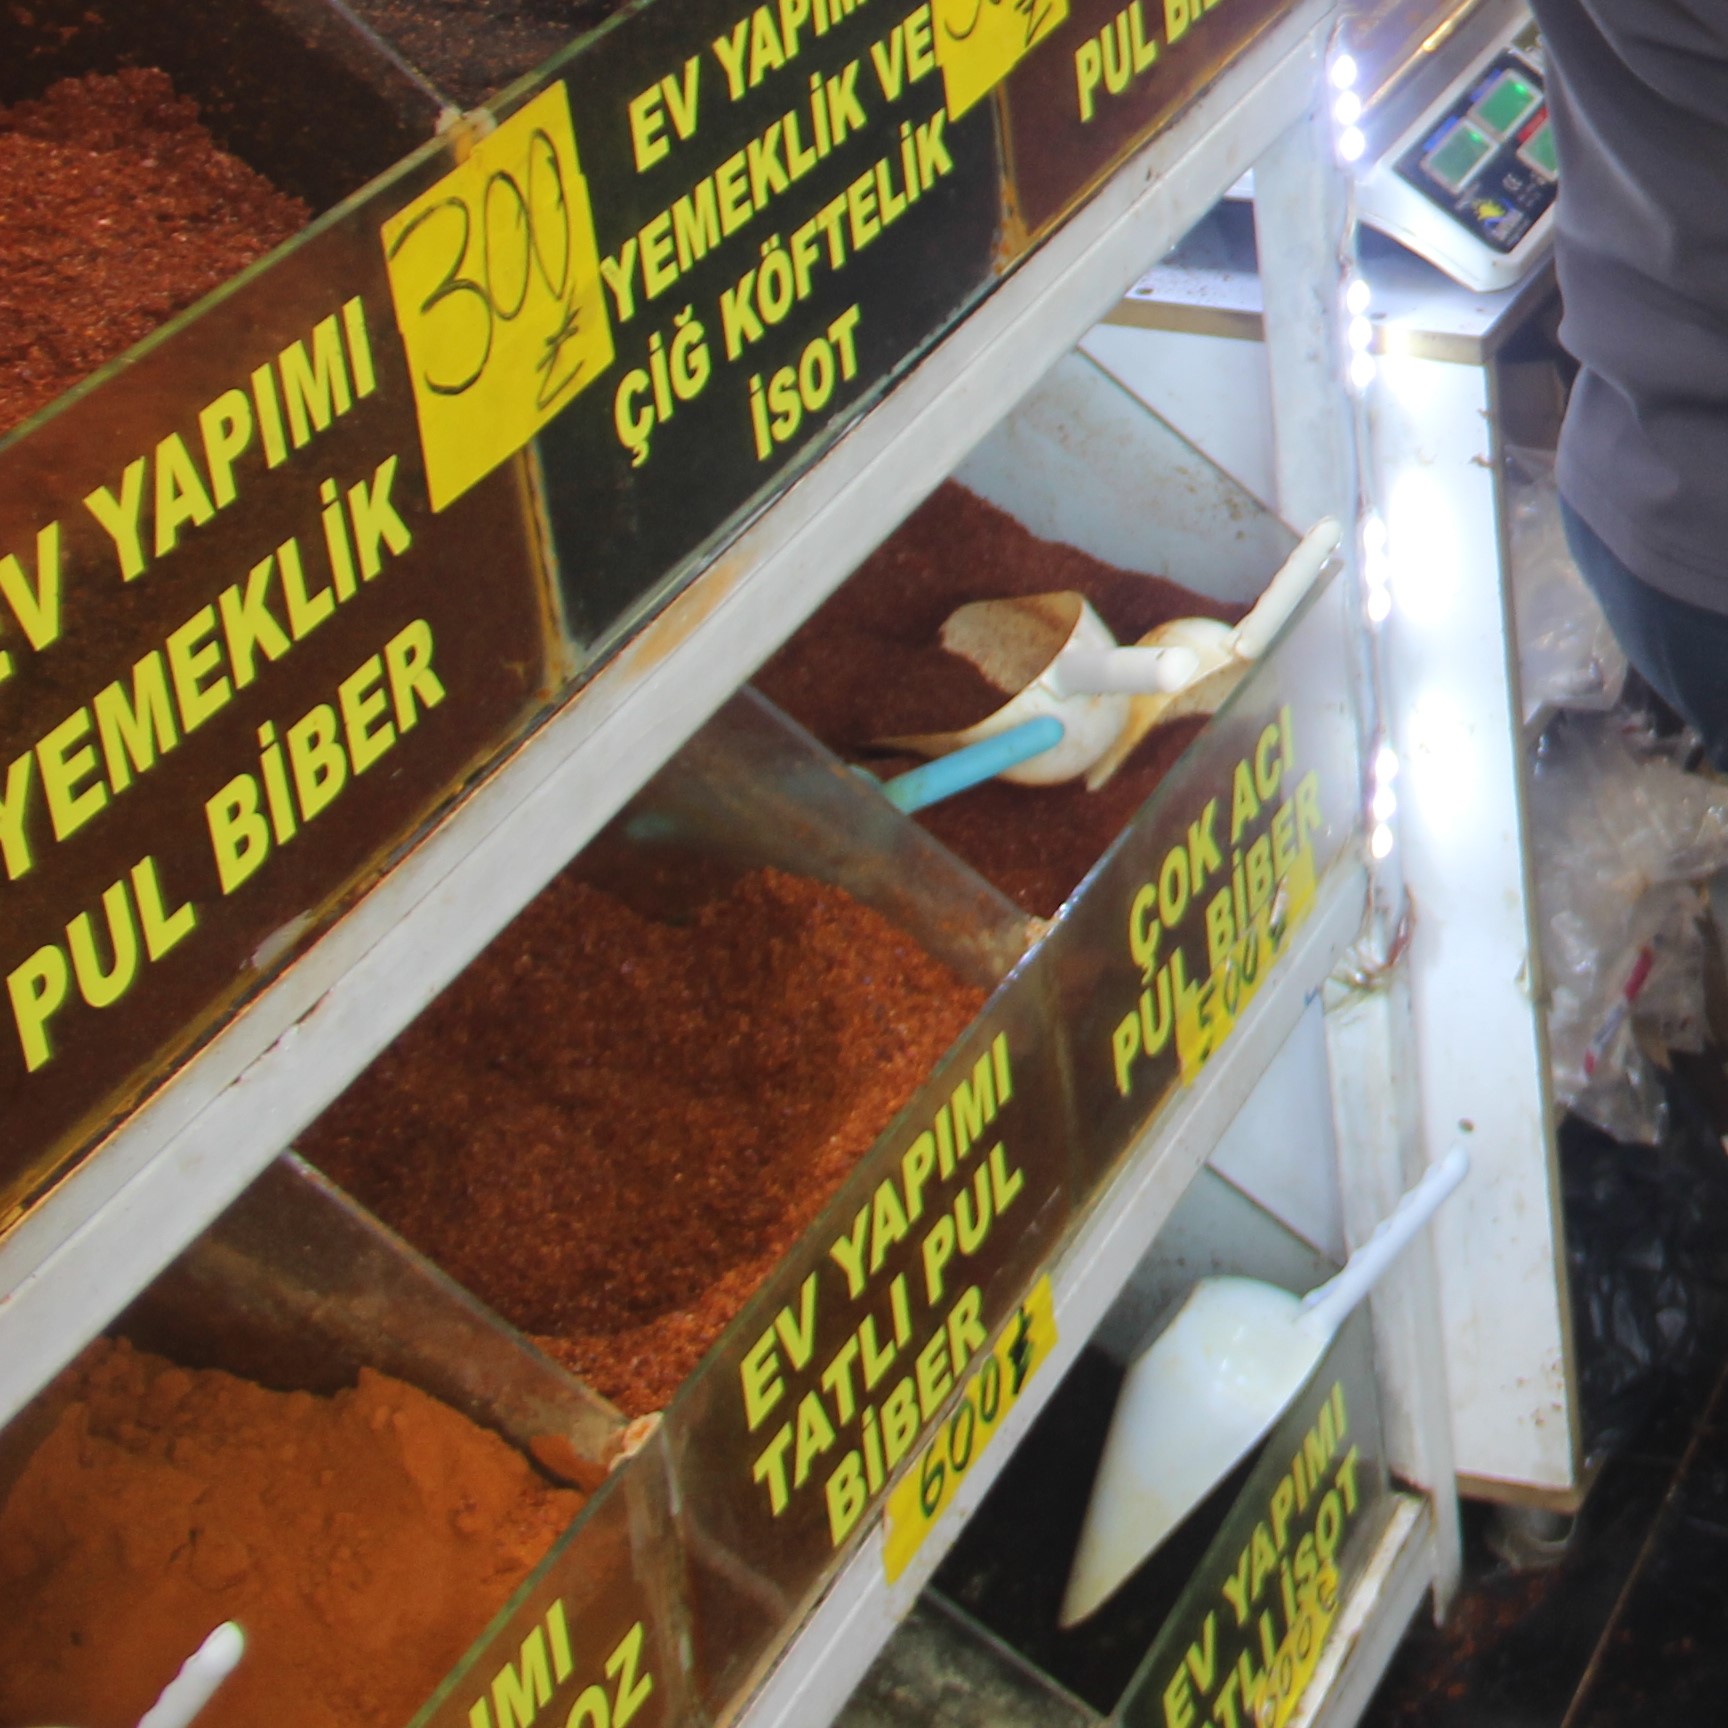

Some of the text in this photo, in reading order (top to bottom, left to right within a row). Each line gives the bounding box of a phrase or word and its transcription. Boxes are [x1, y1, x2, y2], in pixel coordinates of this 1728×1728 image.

[601, 3, 940, 322] YEMEKLİK VE
[629, 56, 700, 172] EV
[1075, 3, 1155, 123] PUL
[390, 128, 573, 397] 300
[614, 106, 953, 465] ÇİĞ KÖFTELİK
[749, 304, 859, 460] İSOT
[84, 297, 376, 585] YAPIMI
[0, 456, 412, 877] YEMEKLİK
[7, 617, 447, 1072] PUL BİBER
[1112, 769, 1322, 1098] PUL BİBER
[1129, 704, 1295, 985] ÇOK ACI
[741, 1031, 1013, 1431] EV YAPIMI
[753, 1143, 1023, 1516] TATLI PUL
[825, 1286, 988, 1547] BİBER
[1222, 1381, 1347, 1626] YAPIMI
